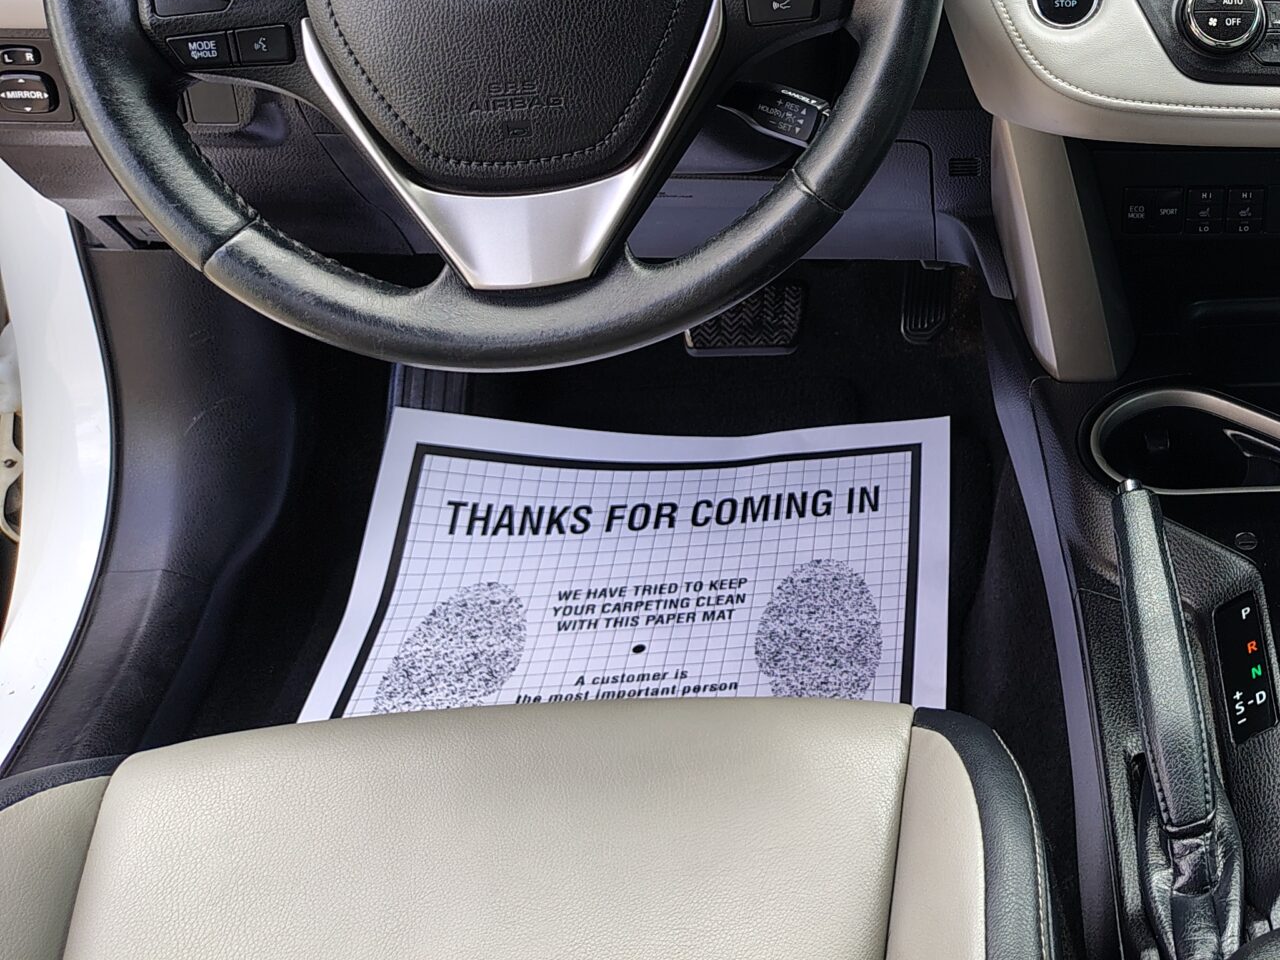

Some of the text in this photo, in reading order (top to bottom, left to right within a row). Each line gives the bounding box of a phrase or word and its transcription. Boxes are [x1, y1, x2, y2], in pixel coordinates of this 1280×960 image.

[1054, 0, 1078, 8] STOP
[1225, 17, 1242, 26] OFF
[188, 40, 217, 51] MODE
[4, 52, 35, 63] L R
[197, 50, 218, 58] HOLD
[6, 90, 44, 100] MIRROR
[781, 89, 810, 103] CANCEL
[784, 100, 800, 113] RES
[777, 121, 793, 132] SET
[1129, 205, 1145, 213] ECO
[1159, 208, 1178, 216] SPORT
[446, 485, 881, 537] THANKS FOR COMING IN
[557, 577, 748, 602] WE HAVE TRIED TO KEEP
[553, 592, 747, 617] YOUR CARPETING CLEAN
[556, 608, 736, 632] WITH THIS PAPER MAT
[1241, 606, 1251, 620] P
[1247, 640, 1258, 654] R
[574, 668, 689, 687] A customer is
[1251, 664, 1263, 680] N
[515, 681, 739, 705] the most important person
[1235, 690, 1267, 716] S D
